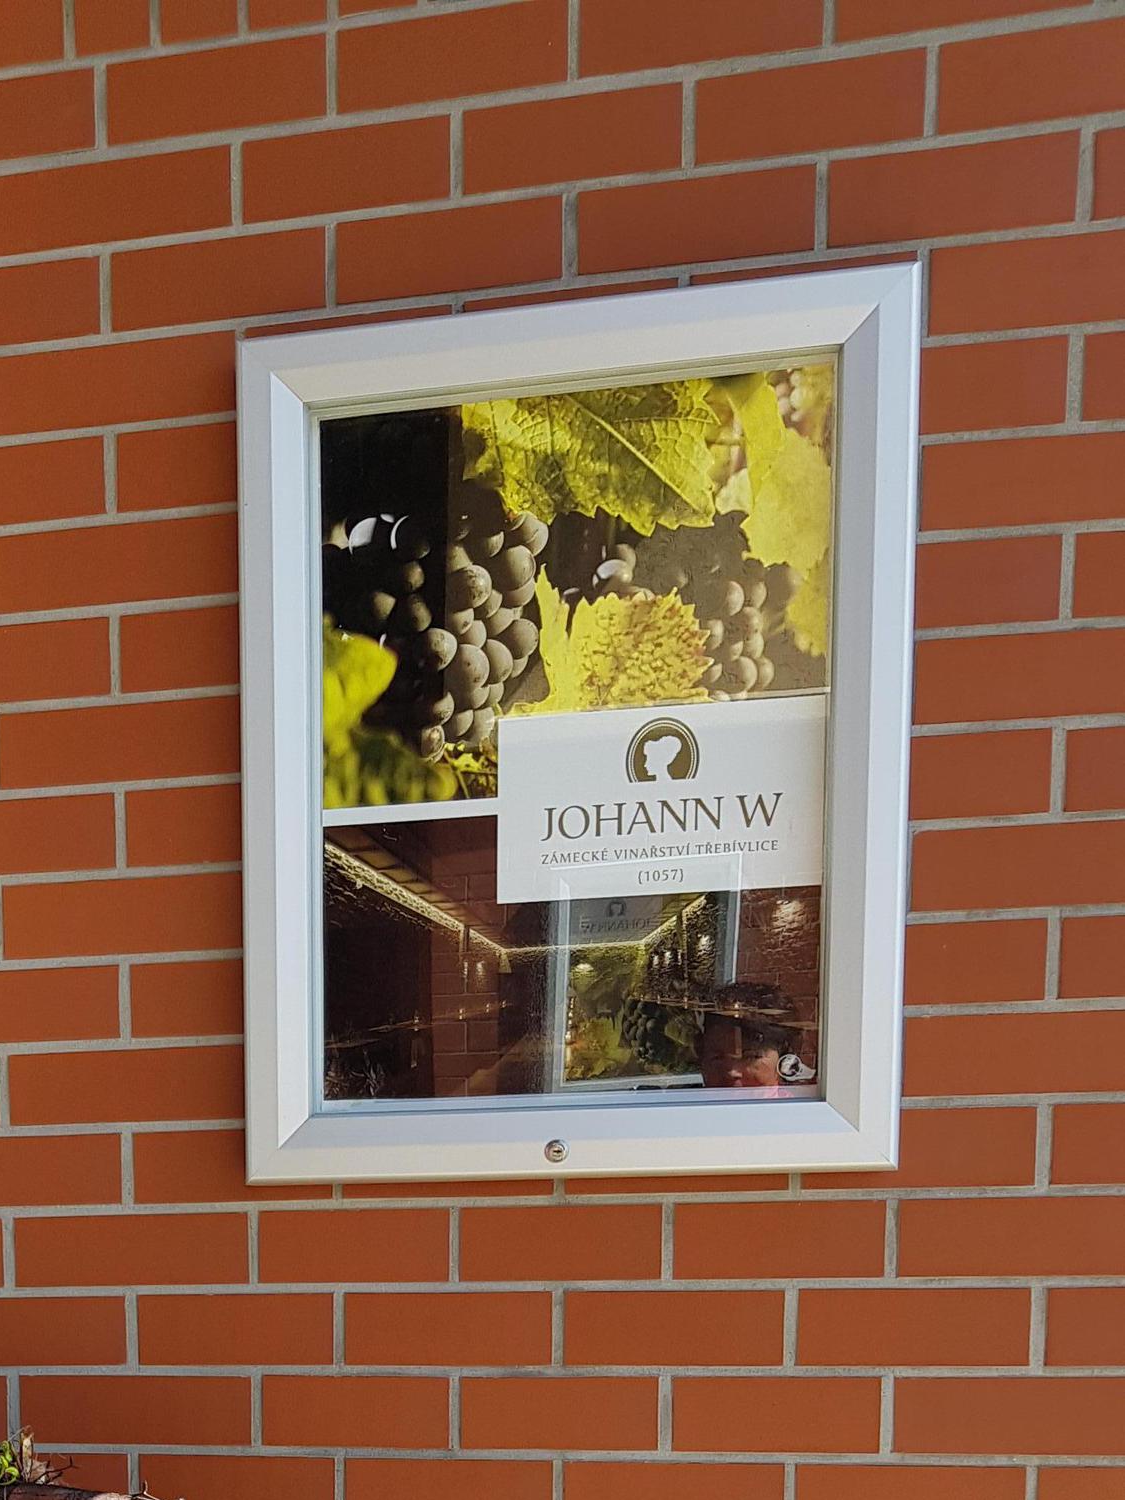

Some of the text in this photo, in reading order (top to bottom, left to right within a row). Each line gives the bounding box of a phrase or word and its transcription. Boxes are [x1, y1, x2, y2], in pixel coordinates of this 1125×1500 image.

[540, 792, 783, 842] JOHANN W
[541, 840, 779, 865] ZÁMECKÉ VINAŘSTVÍ TŘEBÍVLICE
